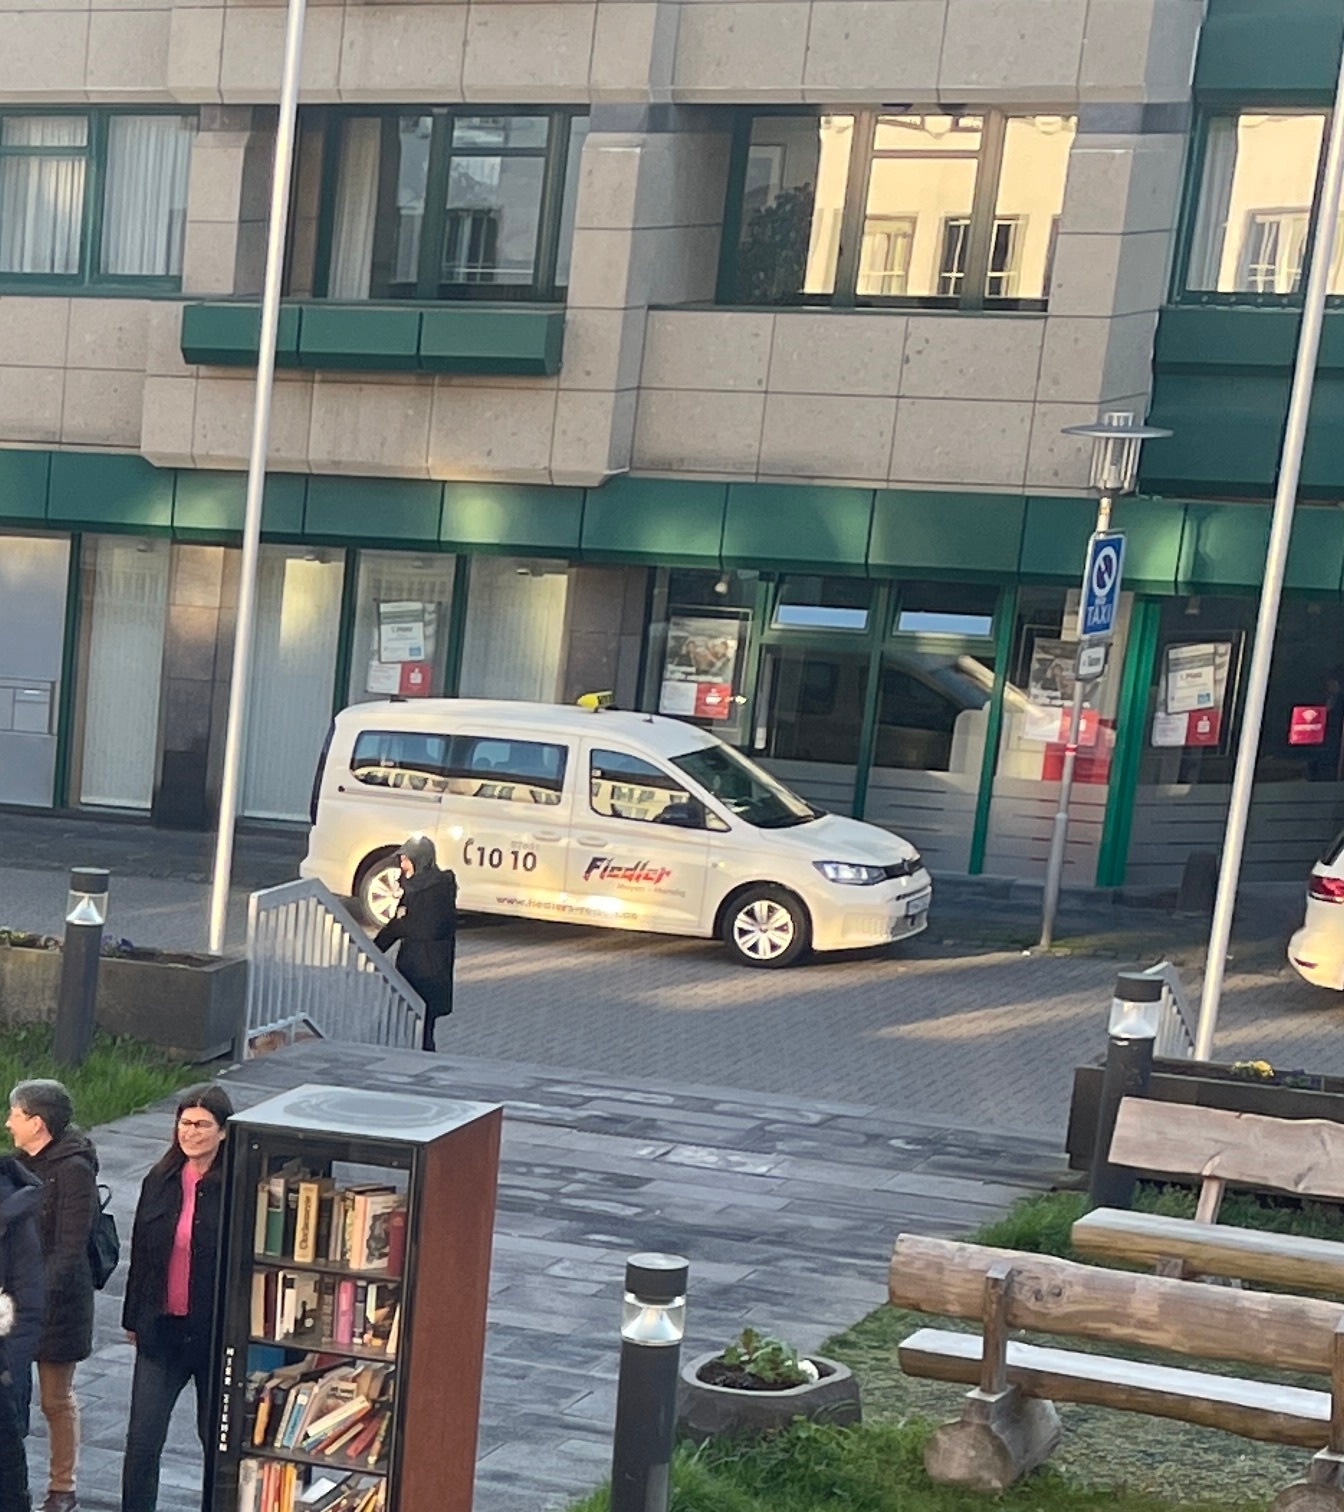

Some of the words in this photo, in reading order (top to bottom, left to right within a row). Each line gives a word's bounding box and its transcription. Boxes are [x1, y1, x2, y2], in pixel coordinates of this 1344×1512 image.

[1087, 603, 1113, 627] TAXI
[477, 846, 503, 869] 10
[511, 850, 537, 872] 10
[583, 857, 672, 885] Fiedler
